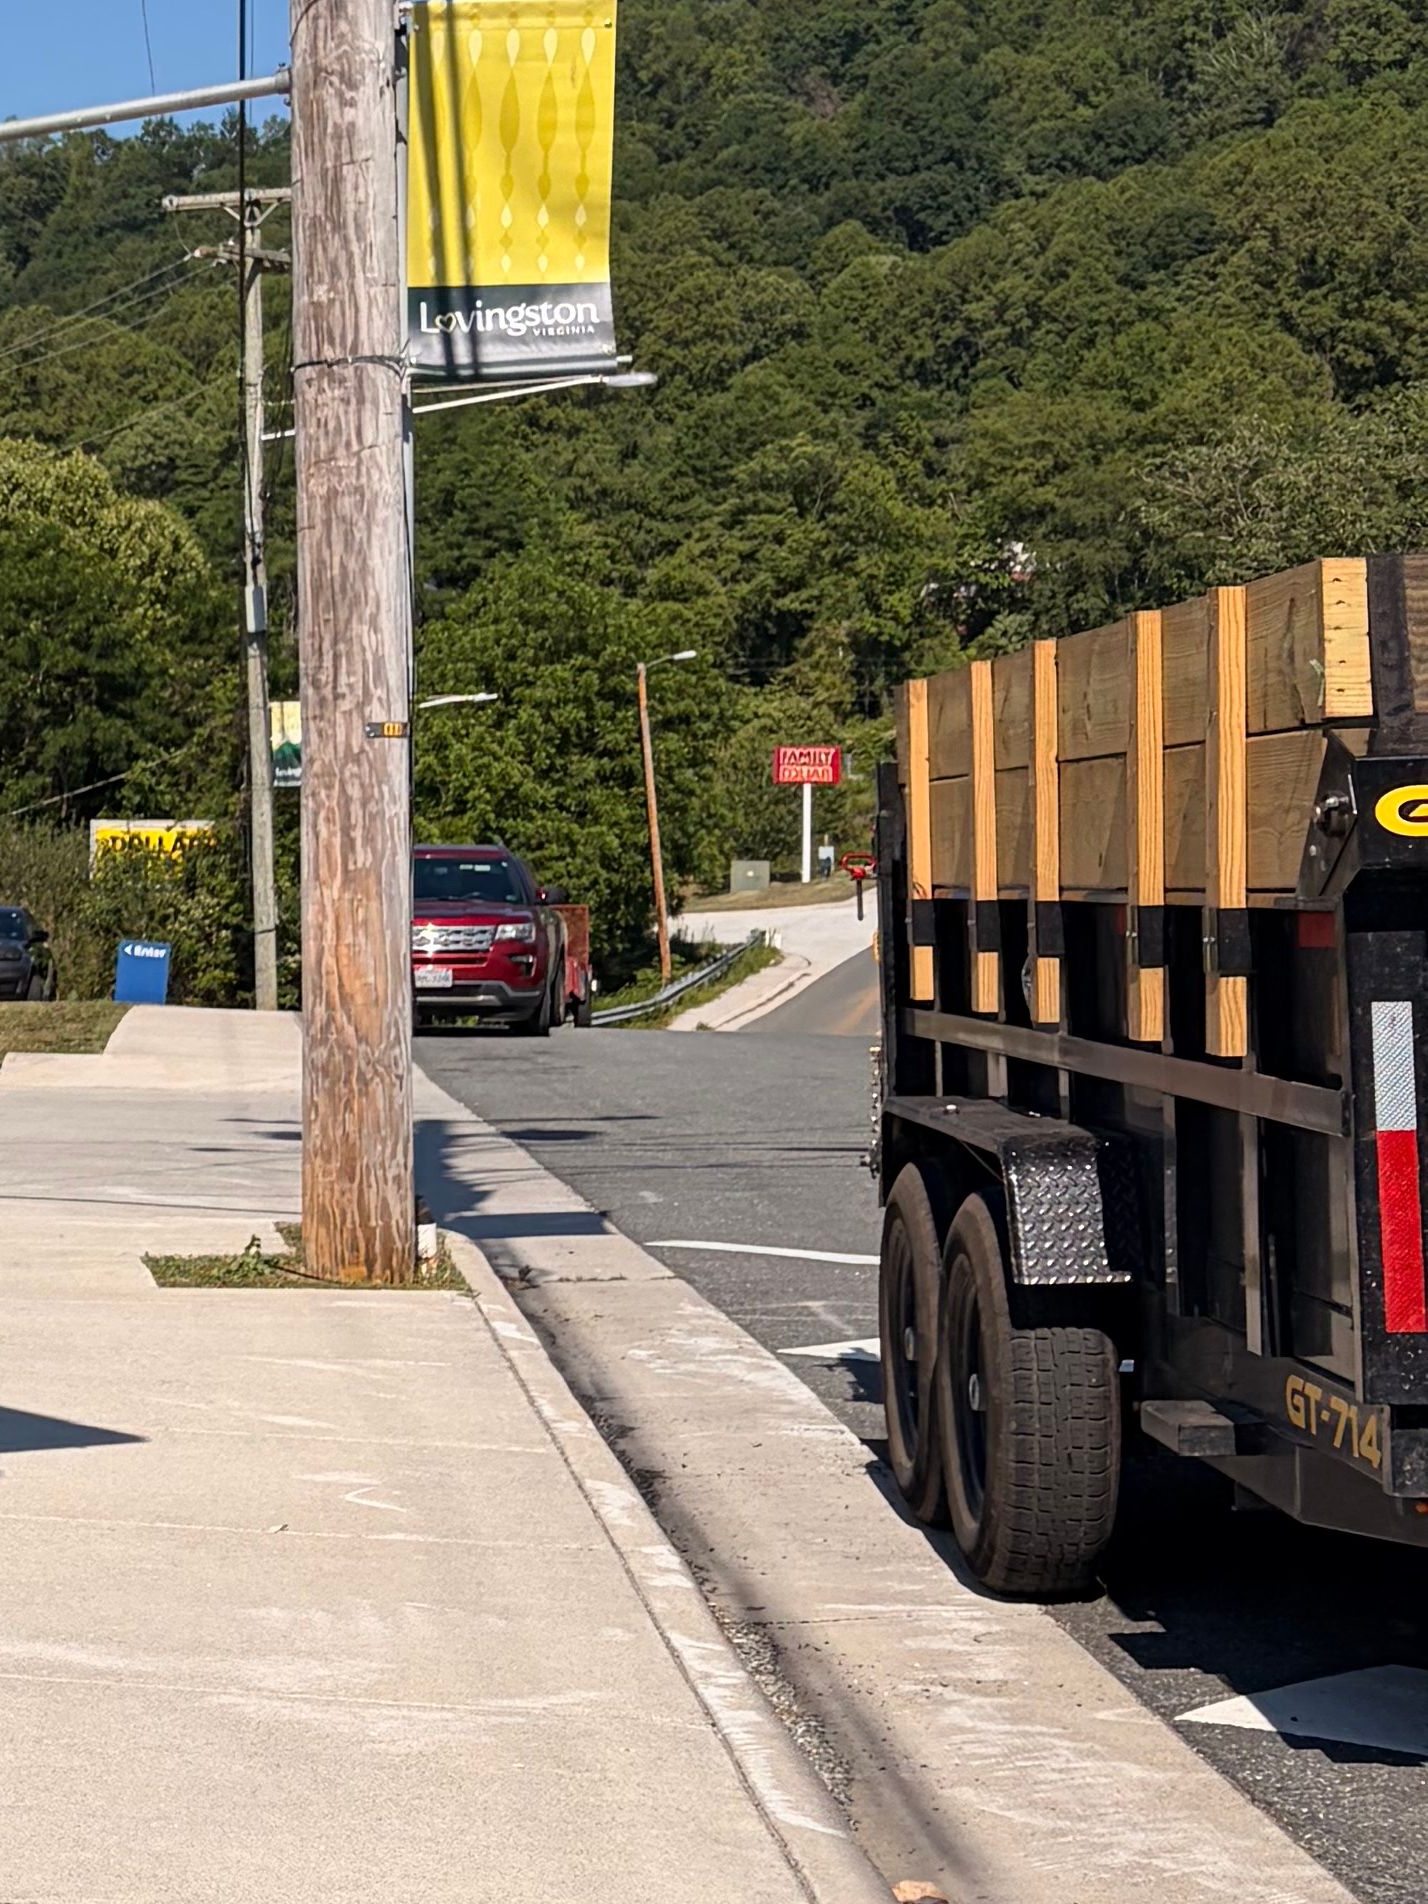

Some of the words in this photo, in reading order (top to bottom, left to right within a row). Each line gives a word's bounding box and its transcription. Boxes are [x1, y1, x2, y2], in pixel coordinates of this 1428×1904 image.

[420, 299, 600, 337] Lovingston
[532, 324, 595, 337] VIRGINIA
[1285, 1374, 1383, 1469] GT-714
